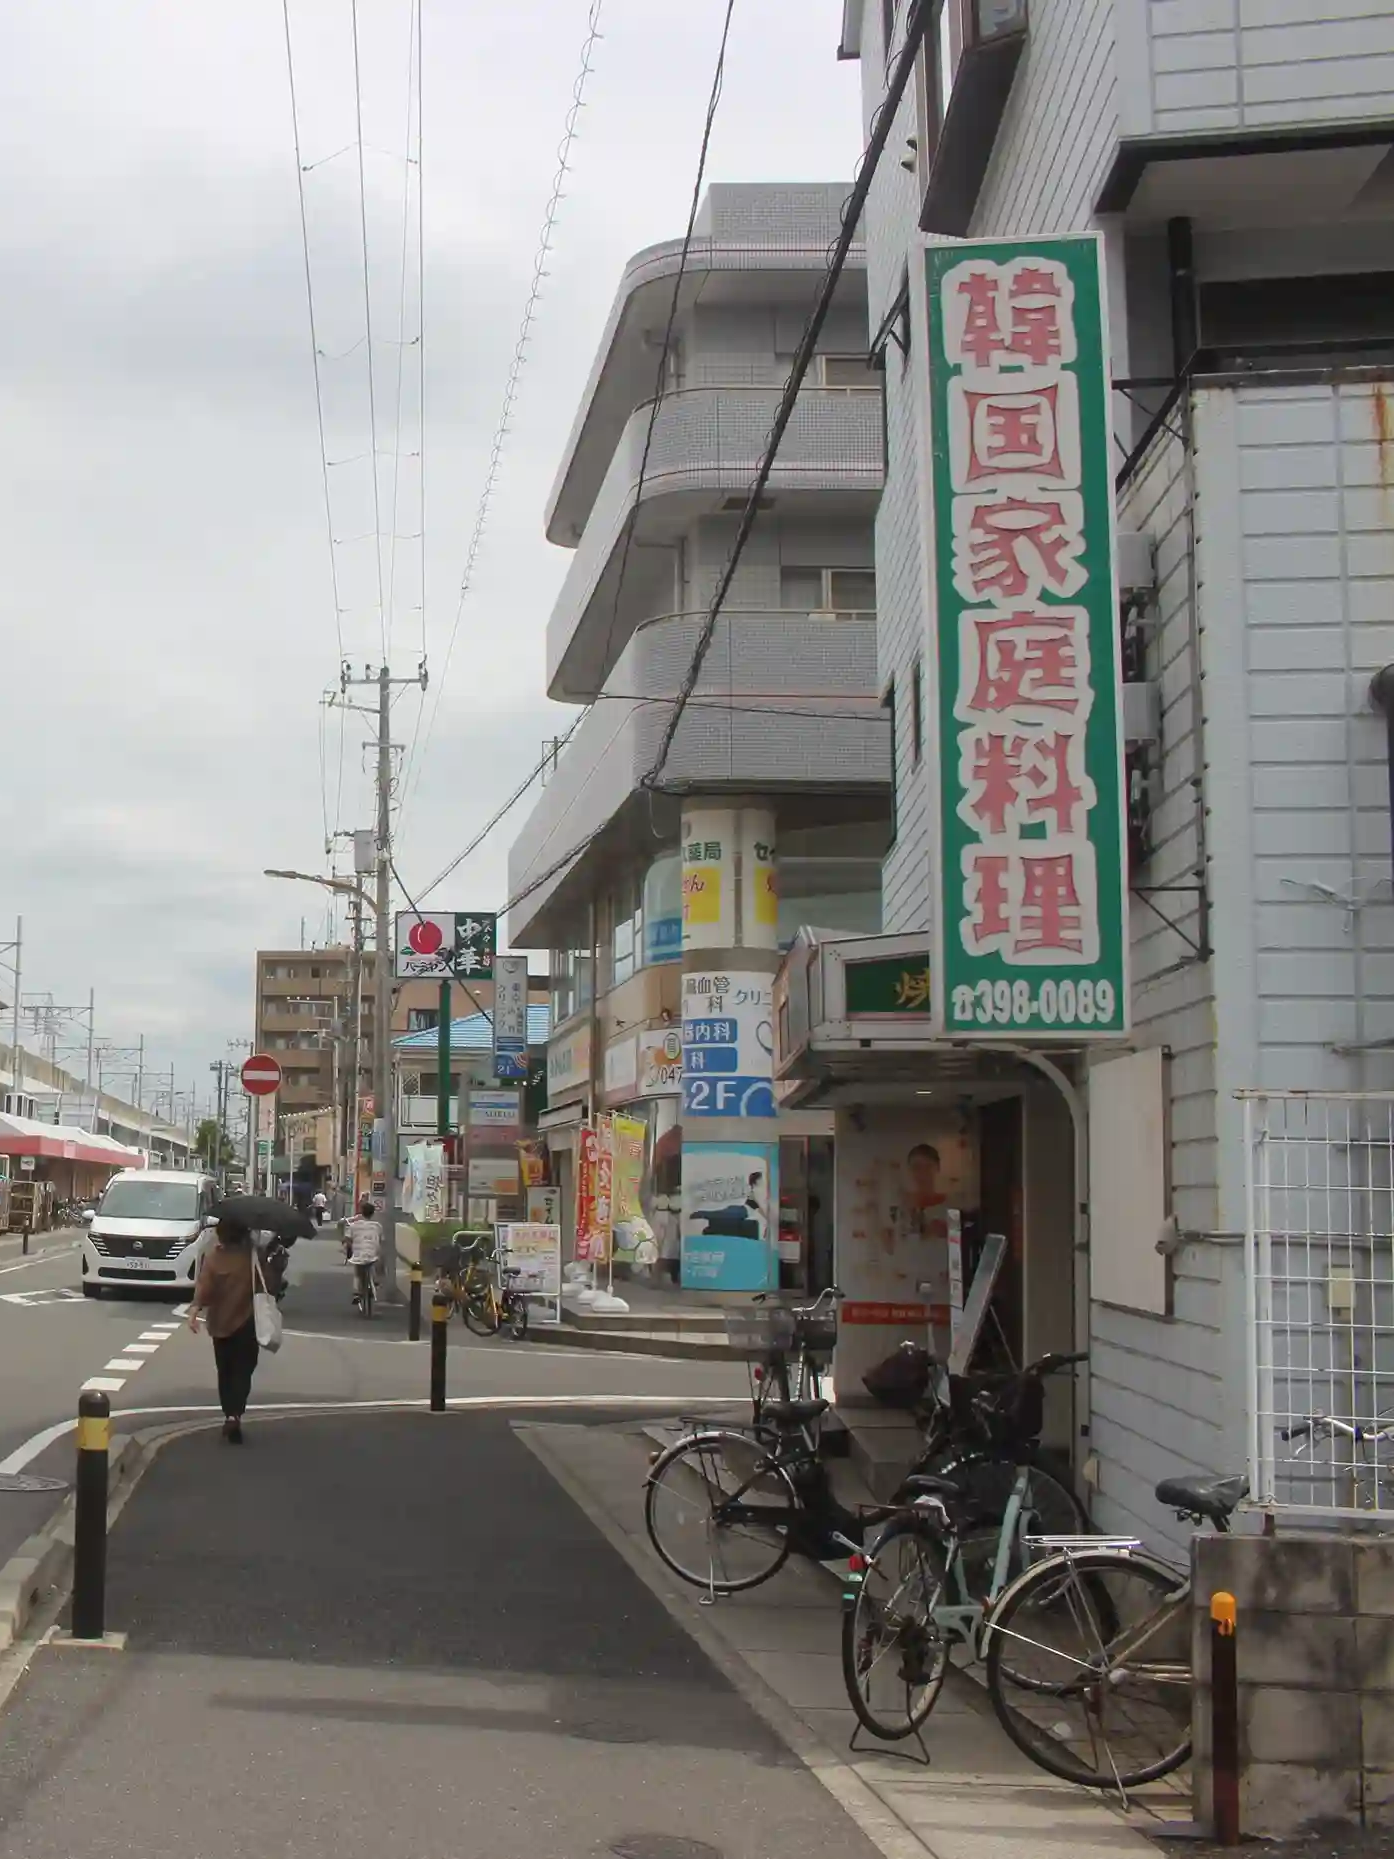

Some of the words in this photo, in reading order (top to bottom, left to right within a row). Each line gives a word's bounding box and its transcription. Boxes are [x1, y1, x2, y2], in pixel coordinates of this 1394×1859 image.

[949, 260, 1095, 961] 韓国家庭料理
[683, 842, 722, 861] 薬局
[974, 979, 1115, 1024] 398-0089
[690, 1080, 737, 1110] 2F
